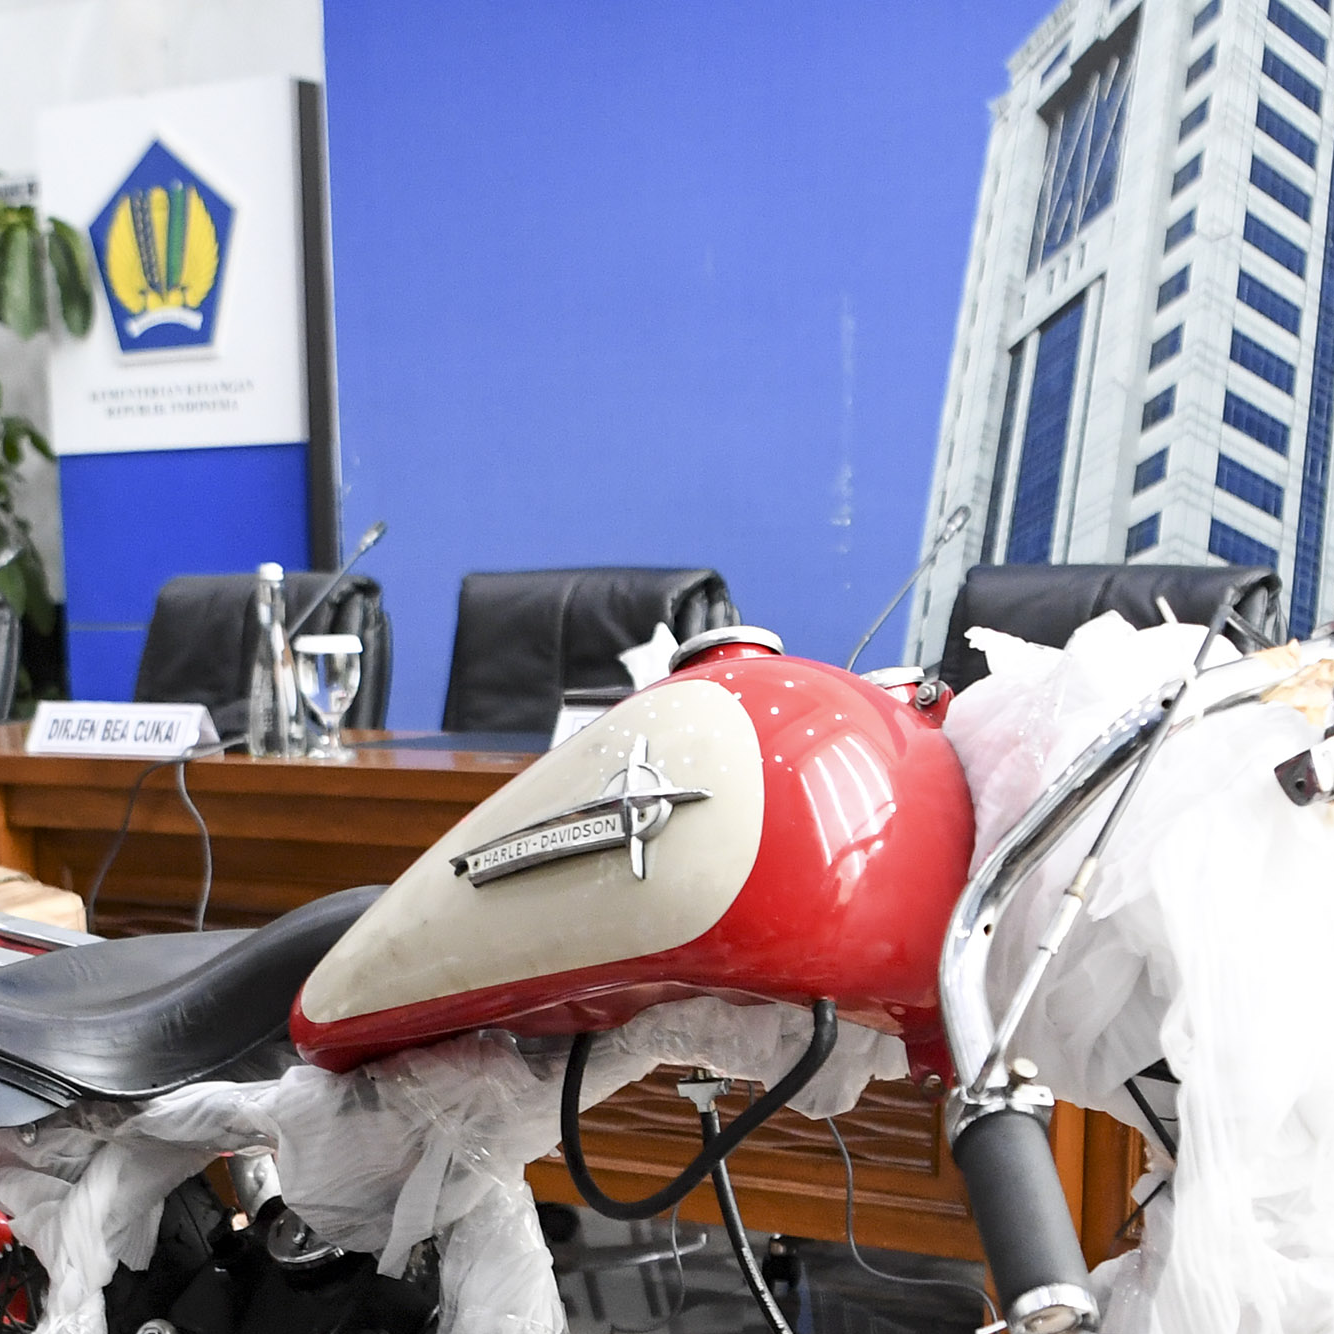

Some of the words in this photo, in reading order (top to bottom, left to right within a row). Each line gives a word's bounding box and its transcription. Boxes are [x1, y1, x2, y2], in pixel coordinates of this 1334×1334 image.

[48, 718, 100, 741] DIRJEN
[101, 719, 129, 742] BEA
[133, 720, 182, 743] CUKAI
